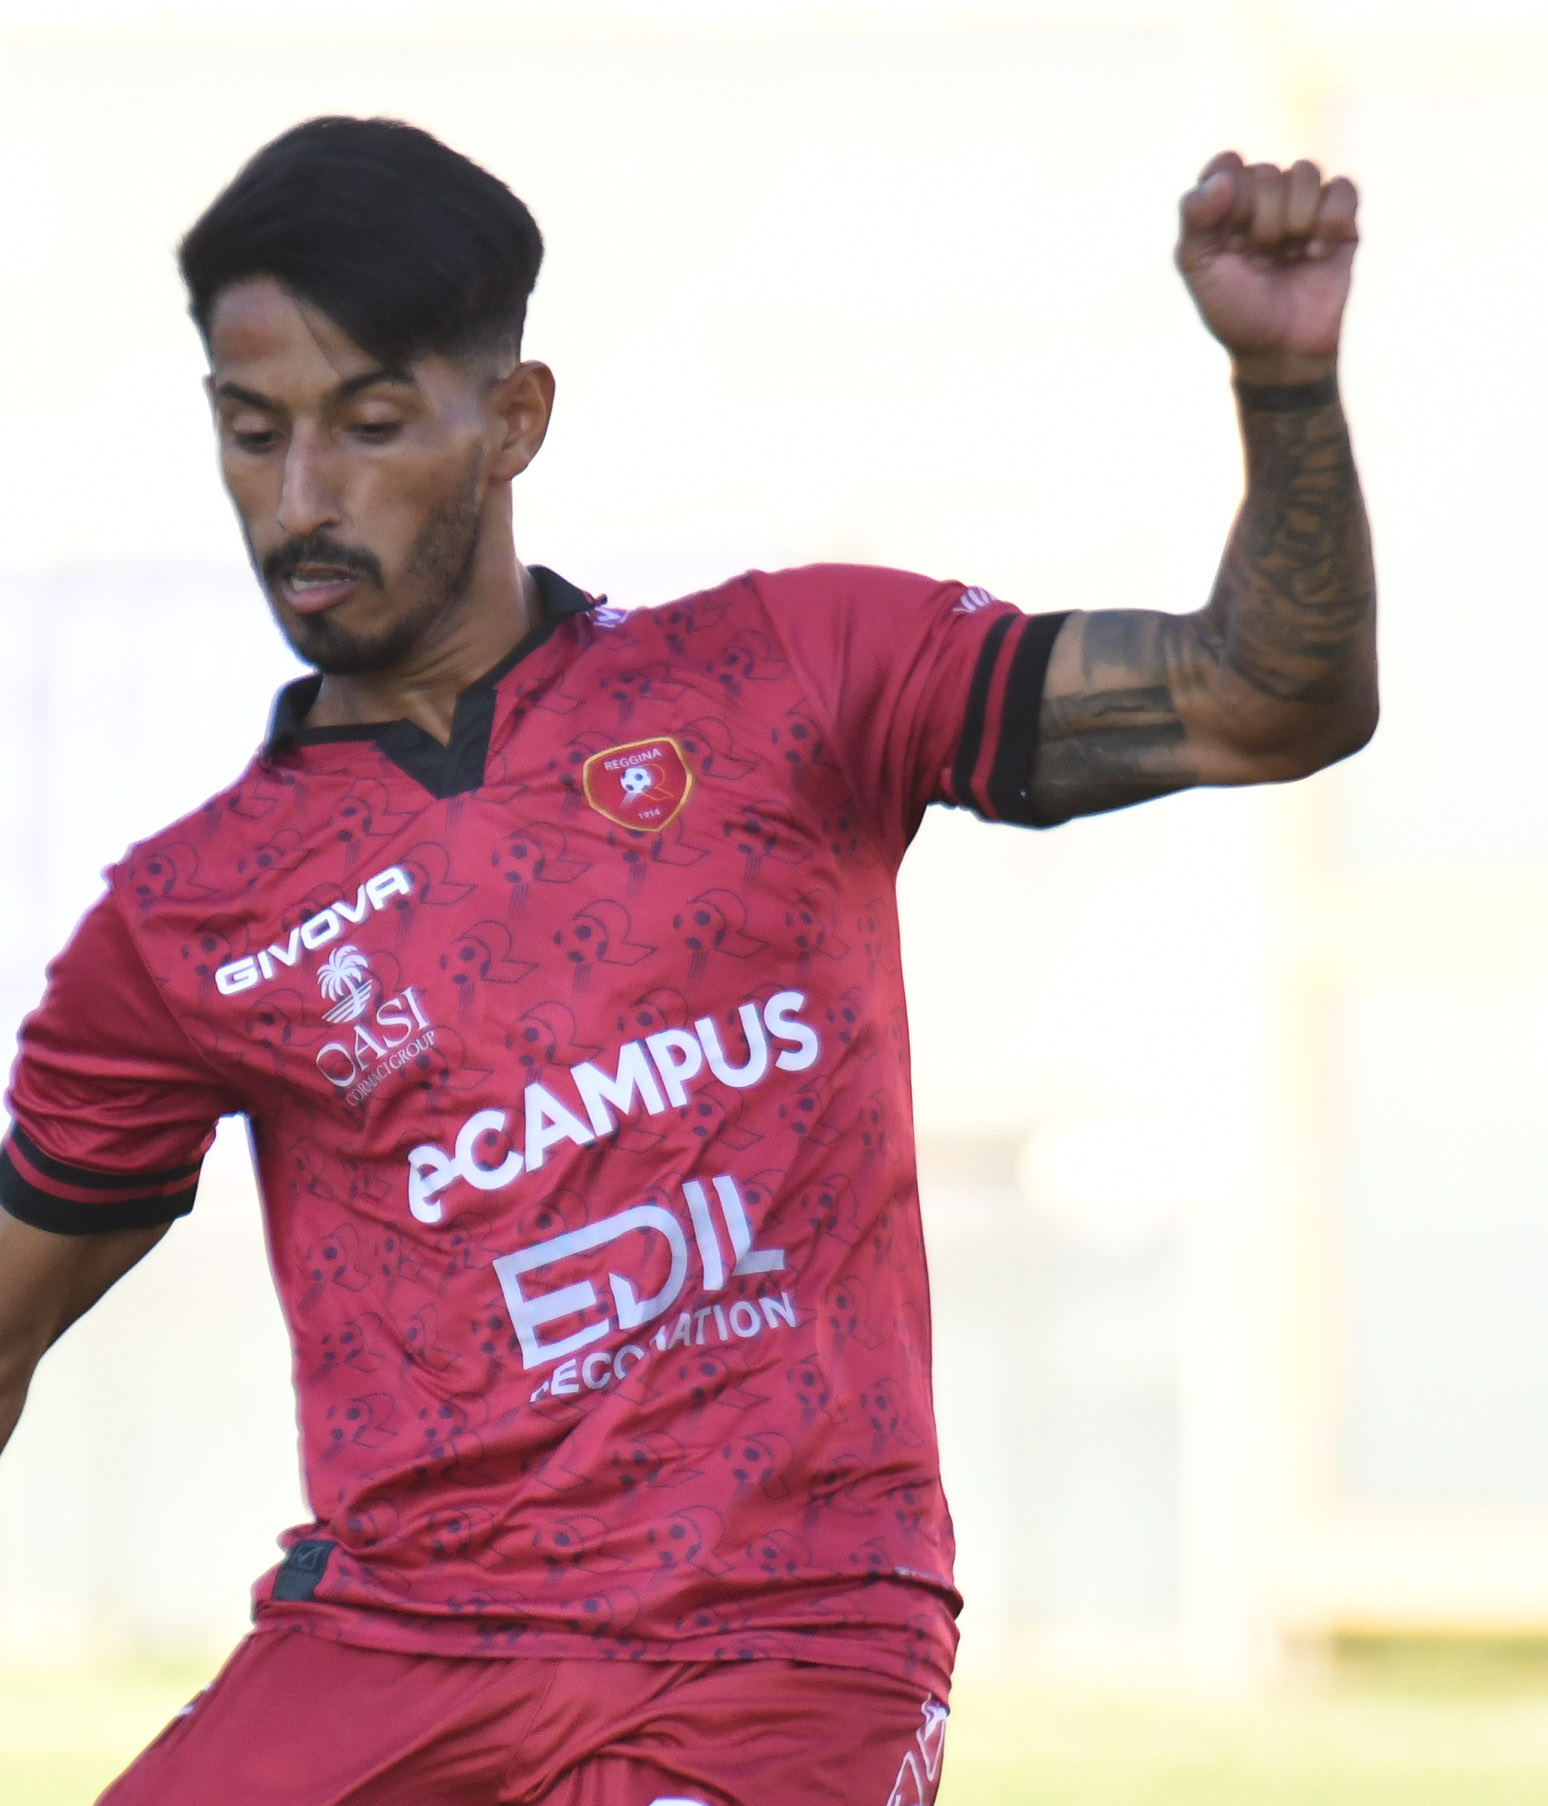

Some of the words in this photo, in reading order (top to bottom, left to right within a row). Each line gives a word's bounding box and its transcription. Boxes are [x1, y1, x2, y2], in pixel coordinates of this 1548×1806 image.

[603, 747, 662, 771] REGGINA
[638, 807, 661, 820] 1914
[214, 866, 410, 996] GIVOVA
[315, 986, 430, 1088] OASI
[388, 1030, 435, 1070] GROUP
[407, 990, 819, 1225] eCAMPUS
[491, 1174, 785, 1371] EDIL
